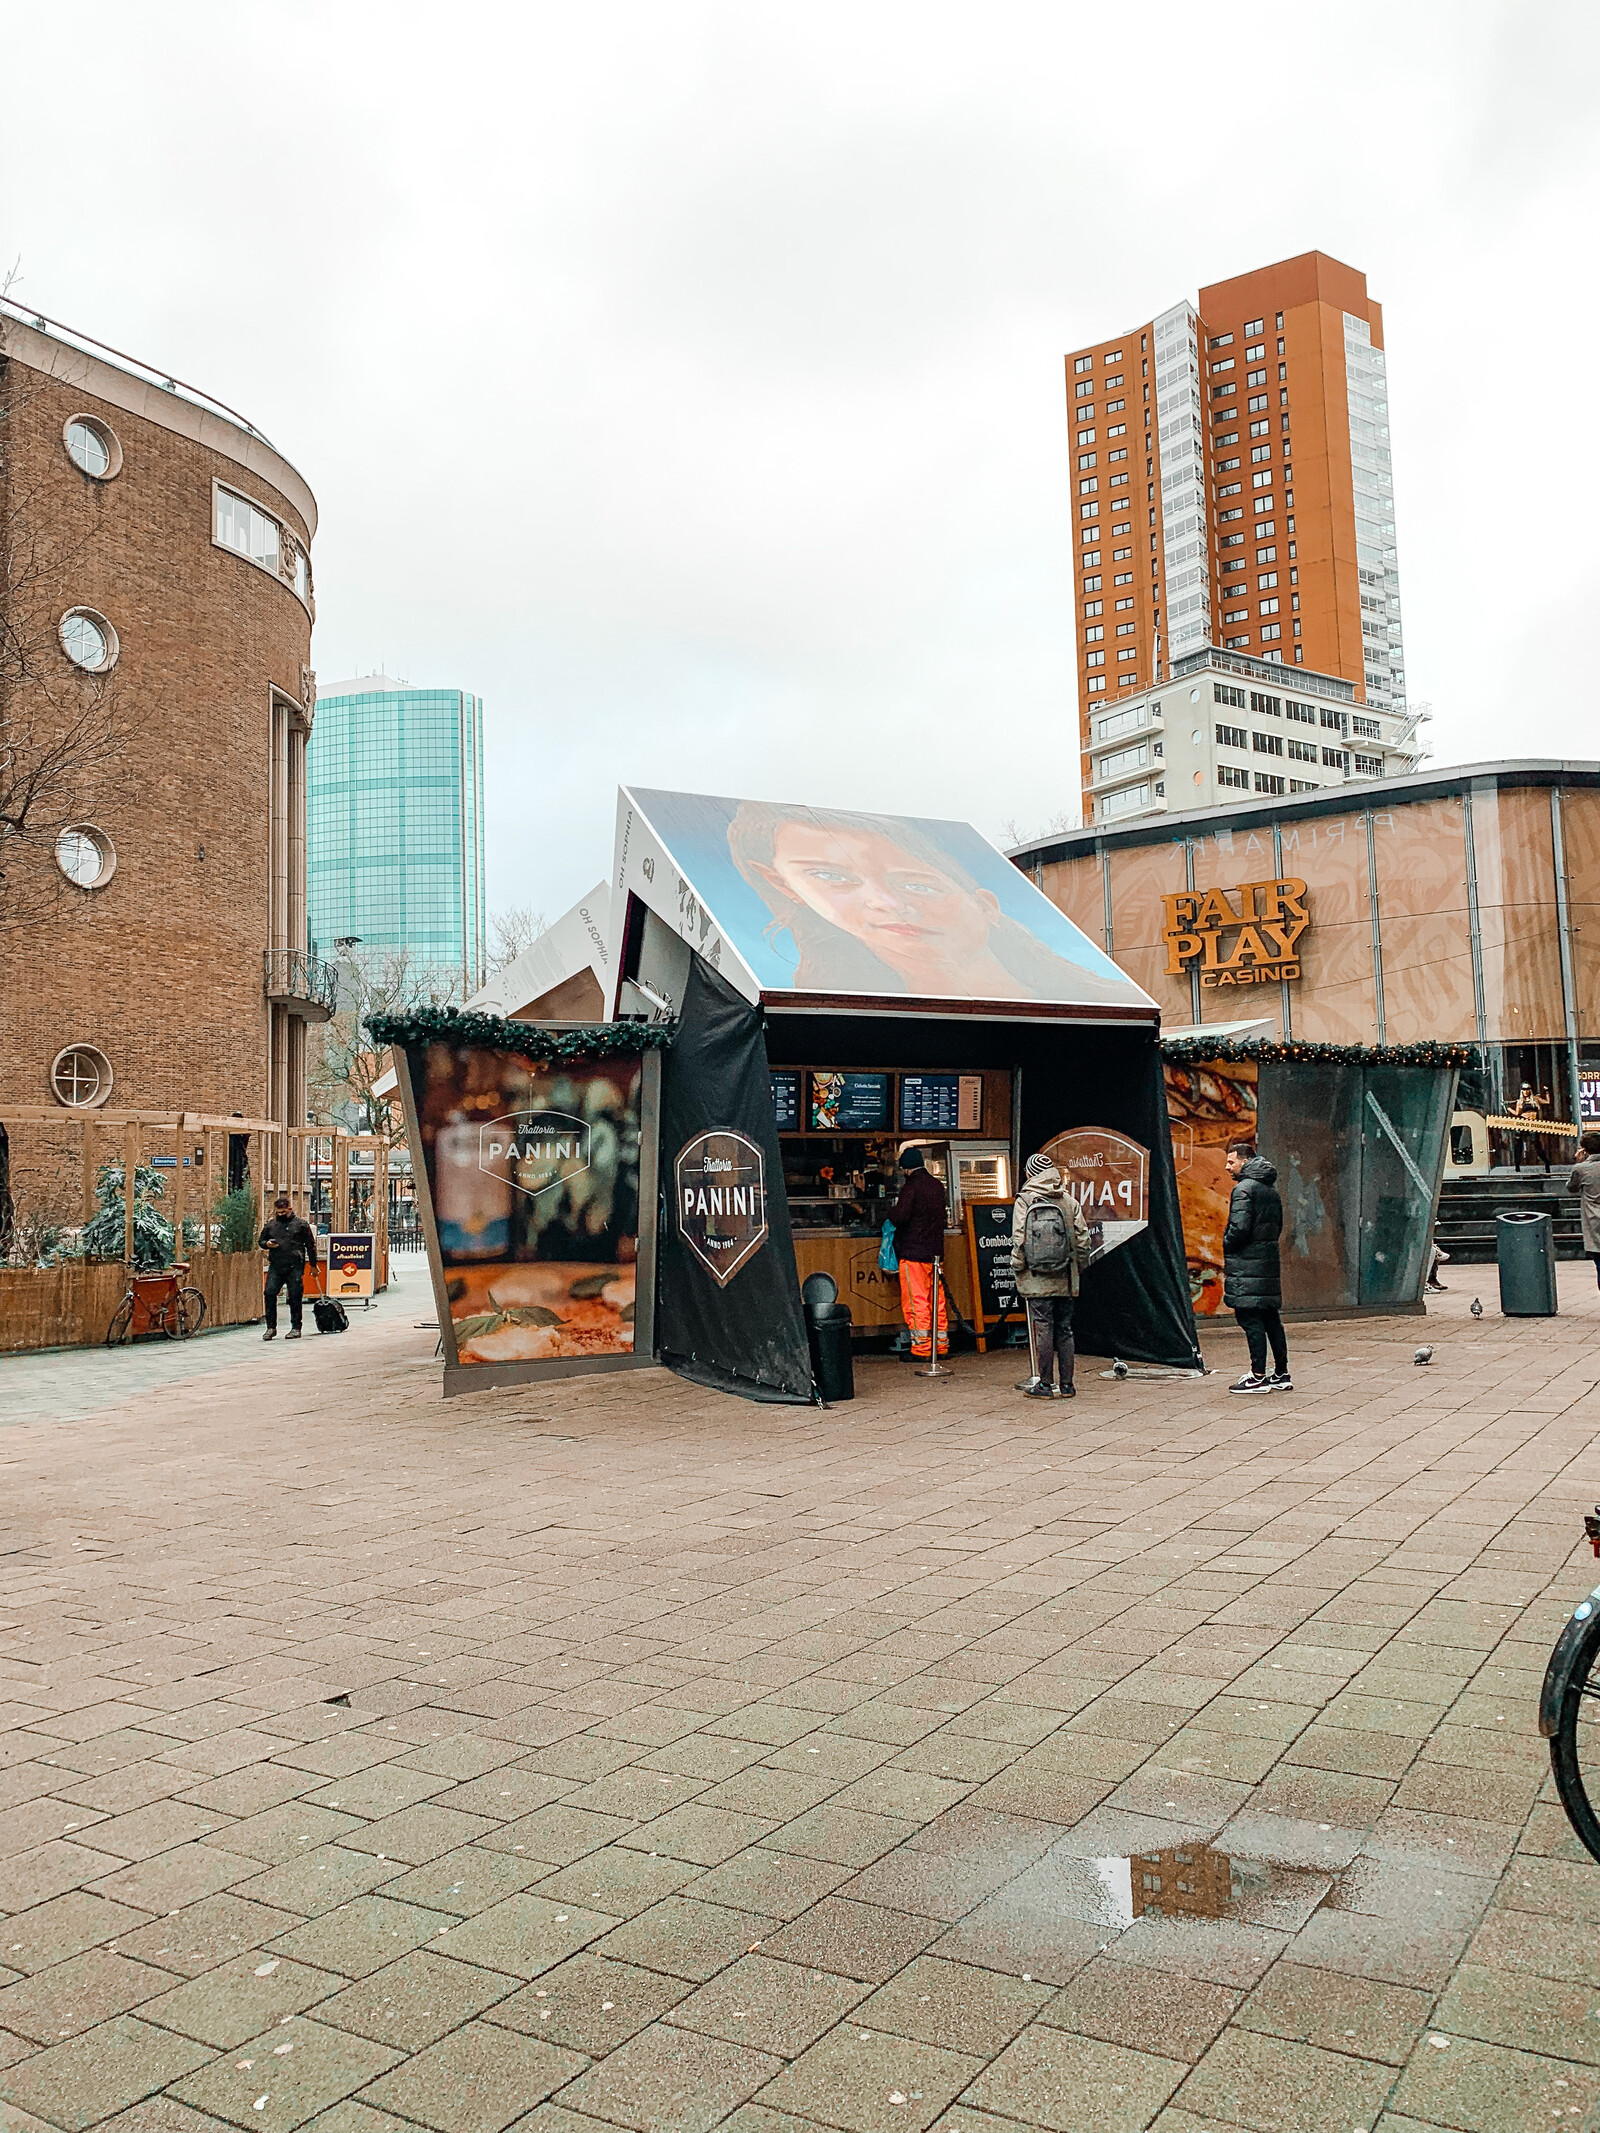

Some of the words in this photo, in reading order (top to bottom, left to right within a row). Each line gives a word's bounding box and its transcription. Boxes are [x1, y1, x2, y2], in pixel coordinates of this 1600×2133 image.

[622, 811, 633, 864] SOPHIA
[1160, 878, 1309, 932] FAIR
[580, 908, 593, 925] OH
[1162, 920, 1309, 975] PLAY
[1200, 964, 1300, 988] CASINO
[518, 1124, 556, 1135] Trattoria
[489, 1142, 580, 1160] PANINI
[703, 1156, 733, 1173] Trattoria
[684, 1186, 755, 1216] PANINI
[332, 1242, 370, 1252] Donner
[706, 1237, 722, 1250] ANNO
